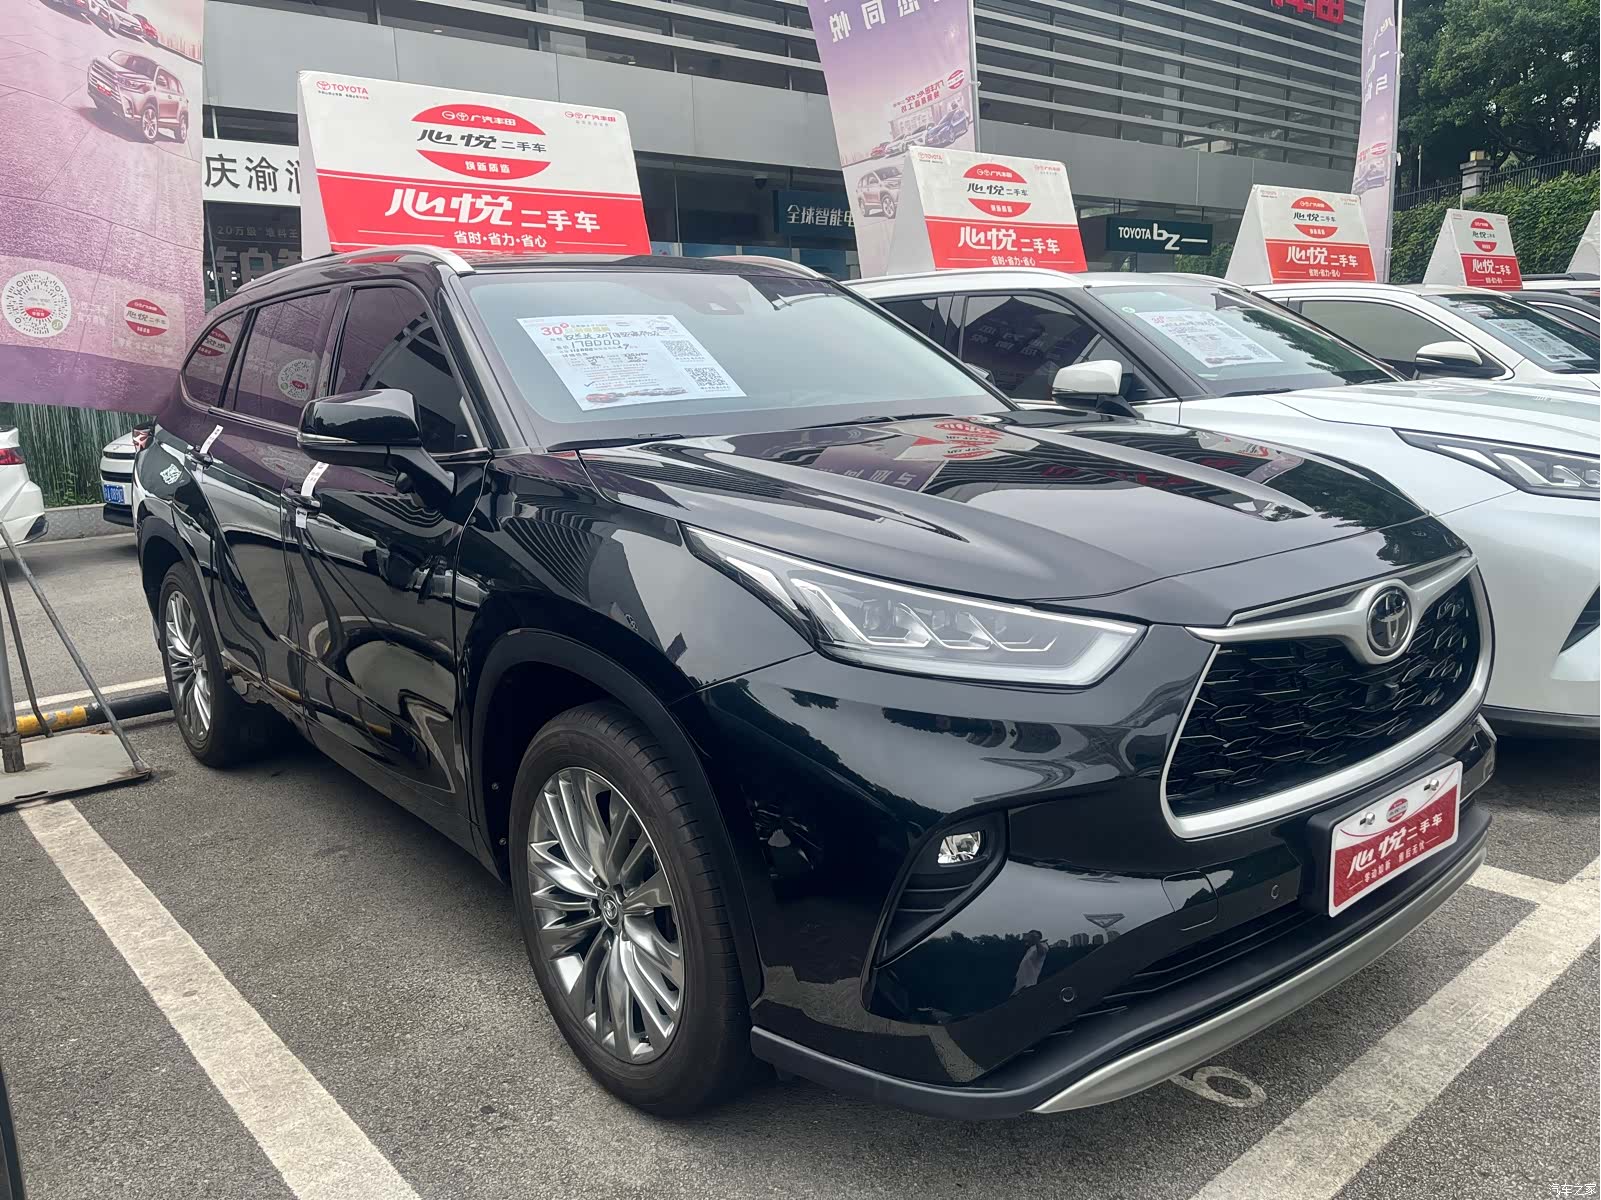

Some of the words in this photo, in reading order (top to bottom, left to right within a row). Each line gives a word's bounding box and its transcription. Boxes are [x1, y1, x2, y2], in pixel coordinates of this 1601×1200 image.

[332, 83, 369, 95] TOYOTA
[470, 114, 517, 127] 广汽丰田
[417, 129, 547, 153] 心悦二手车
[204, 153, 301, 195] 庆渝
[967, 182, 1029, 196] 心悦二手车
[385, 188, 601, 233] 心悦二手车
[787, 204, 856, 227] 全球智能电
[453, 230, 548, 248] 省时·省力·省心
[957, 226, 1061, 254] 心悦二手车
[1118, 226, 1152, 240] TOYOTA
[1286, 246, 1359, 268] 心悦二手车
[1347, 812, 1443, 879] 心悦二手车
